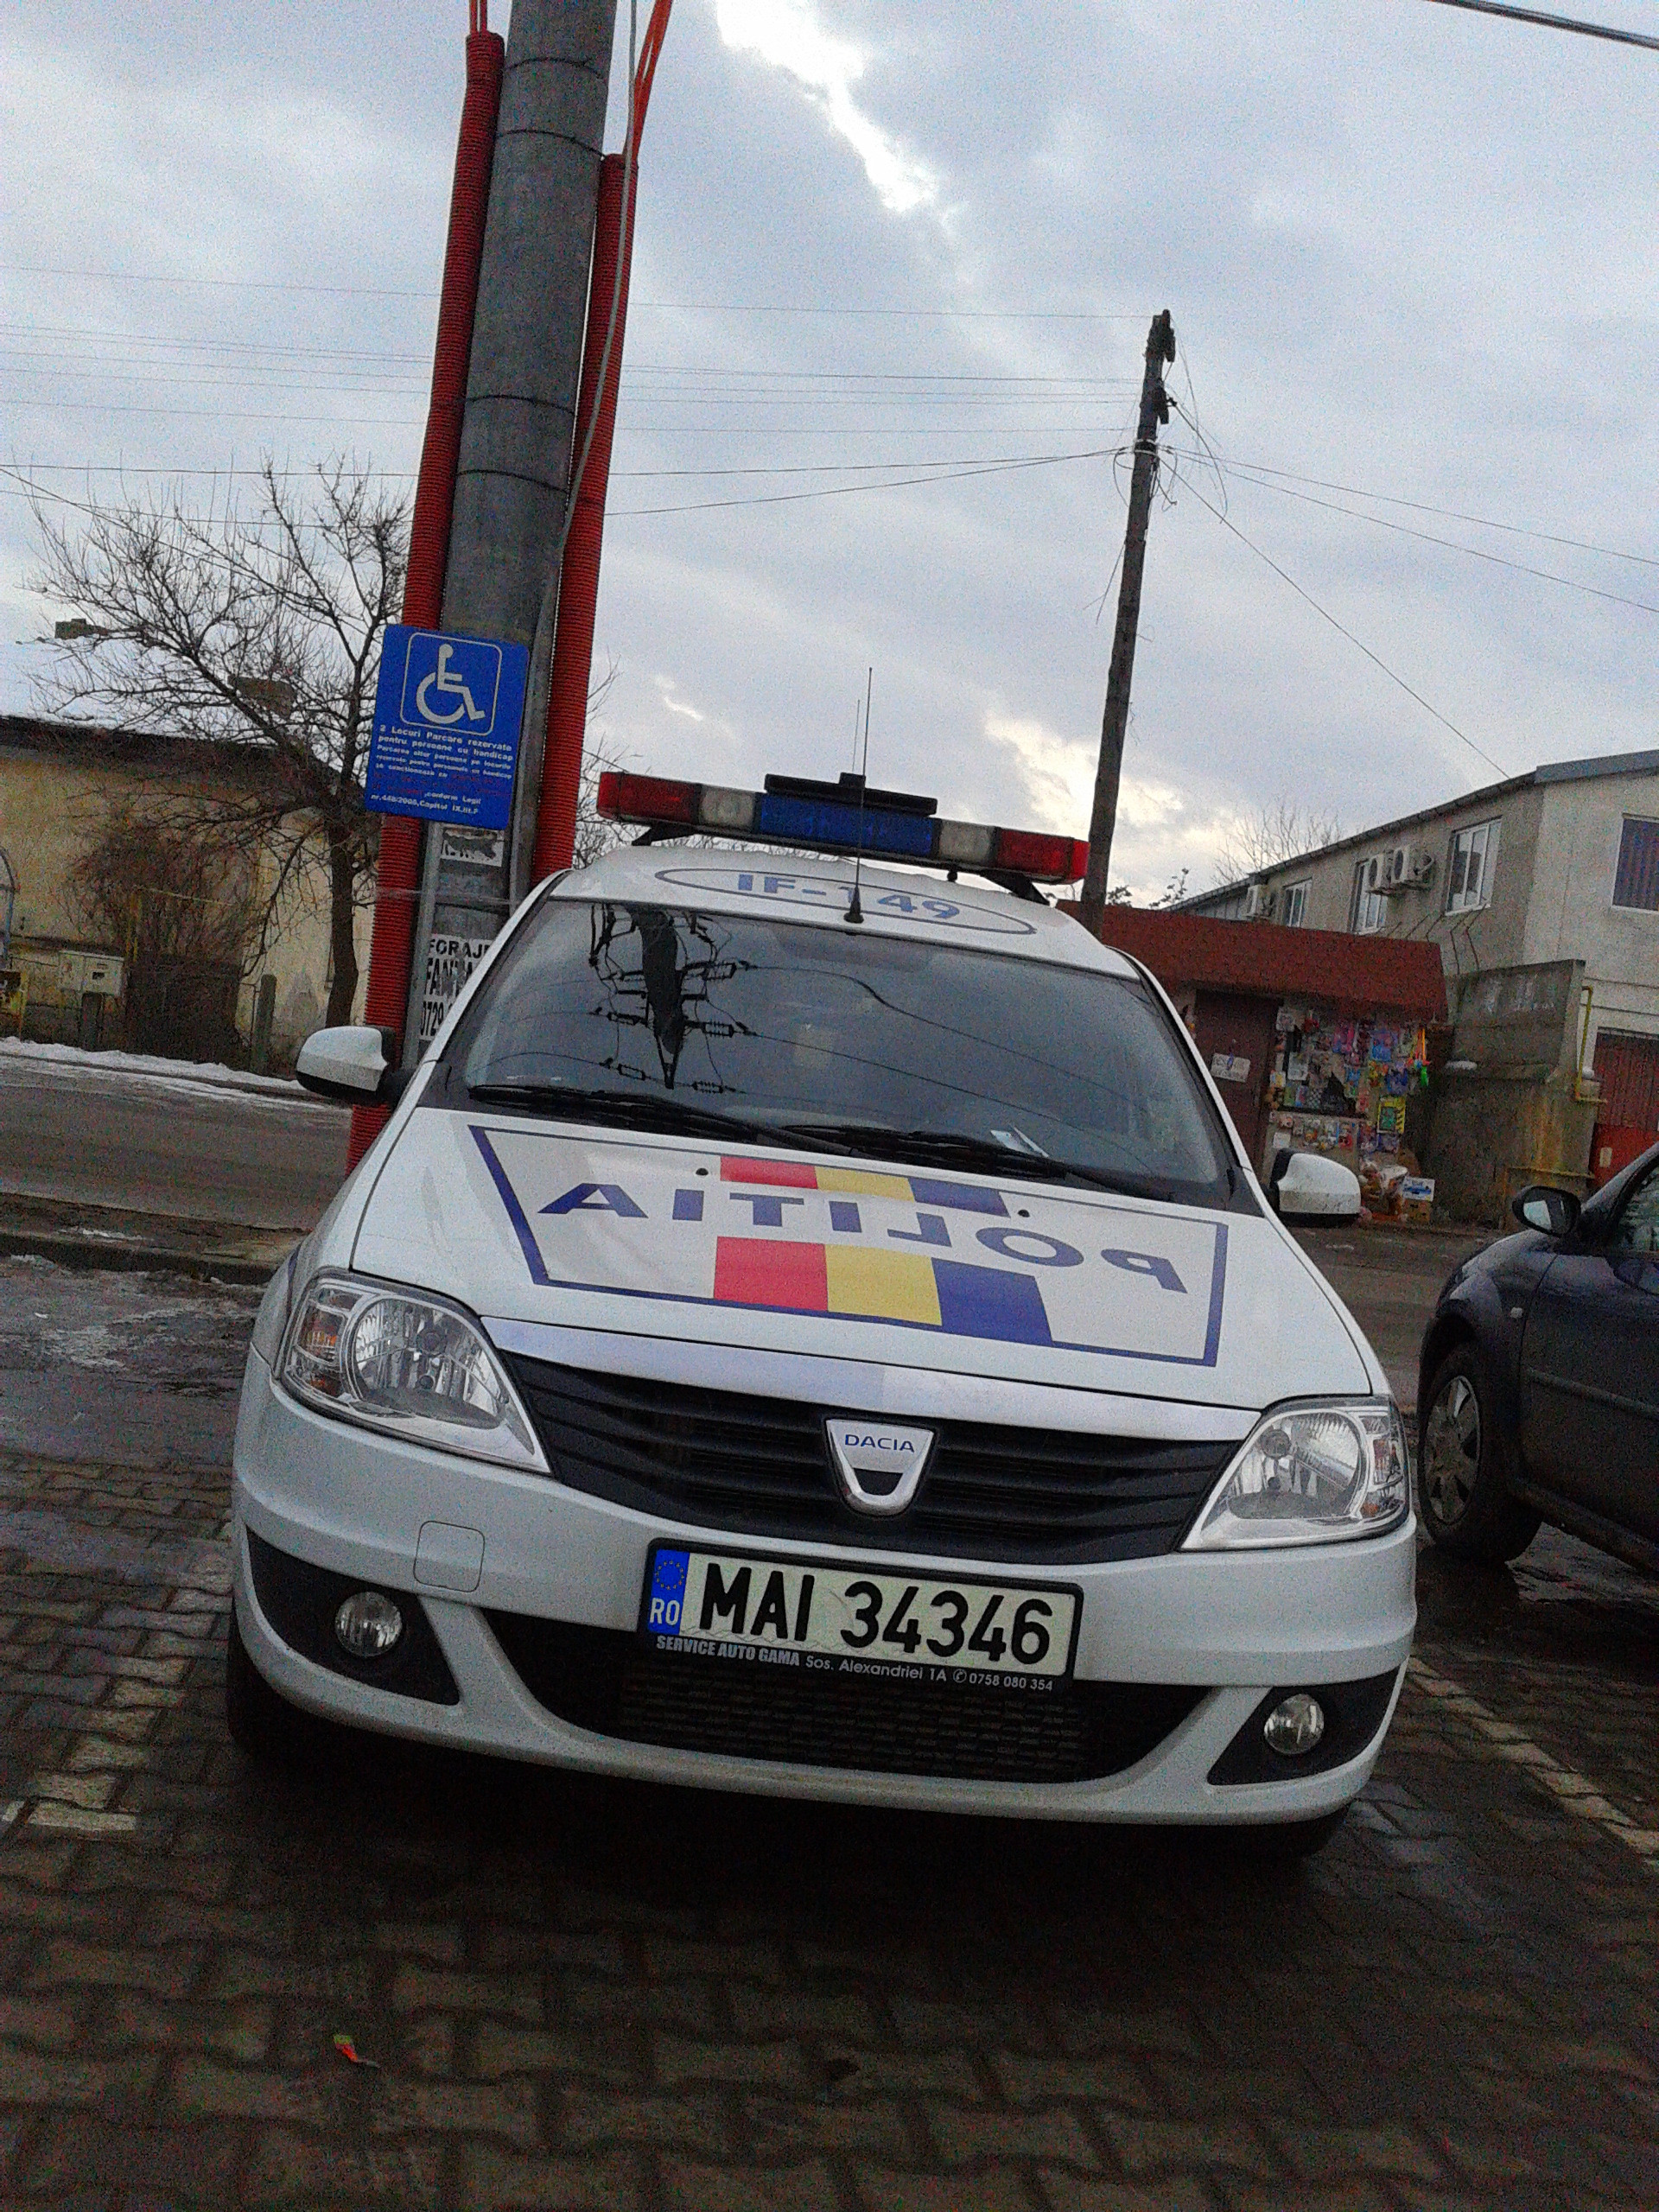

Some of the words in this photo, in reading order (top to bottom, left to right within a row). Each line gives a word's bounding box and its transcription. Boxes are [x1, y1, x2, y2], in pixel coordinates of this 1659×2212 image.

[378, 735, 408, 745] pentru
[411, 741, 453, 753] persoane
[474, 748, 513, 762] handicap
[391, 726, 422, 738] Locuri
[426, 731, 463, 744] Parcare
[467, 739, 512, 752] rezervate
[844, 1434, 915, 1452] DACIA
[649, 1597, 681, 1626] RO
[699, 1562, 815, 1642] MAI
[840, 1580, 1053, 1665] 34346
[656, 1635, 716, 1656] SERVICE
[717, 1642, 756, 1661] AUTO
[758, 1649, 800, 1666] GAMA
[805, 1655, 835, 1670] Sos.
[838, 1659, 923, 1679] Alexandriei
[930, 1668, 947, 1682] 1A
[969, 1673, 1000, 1686] 0758
[1003, 1676, 1027, 1690] 080
[1030, 1680, 1053, 1692] 354
